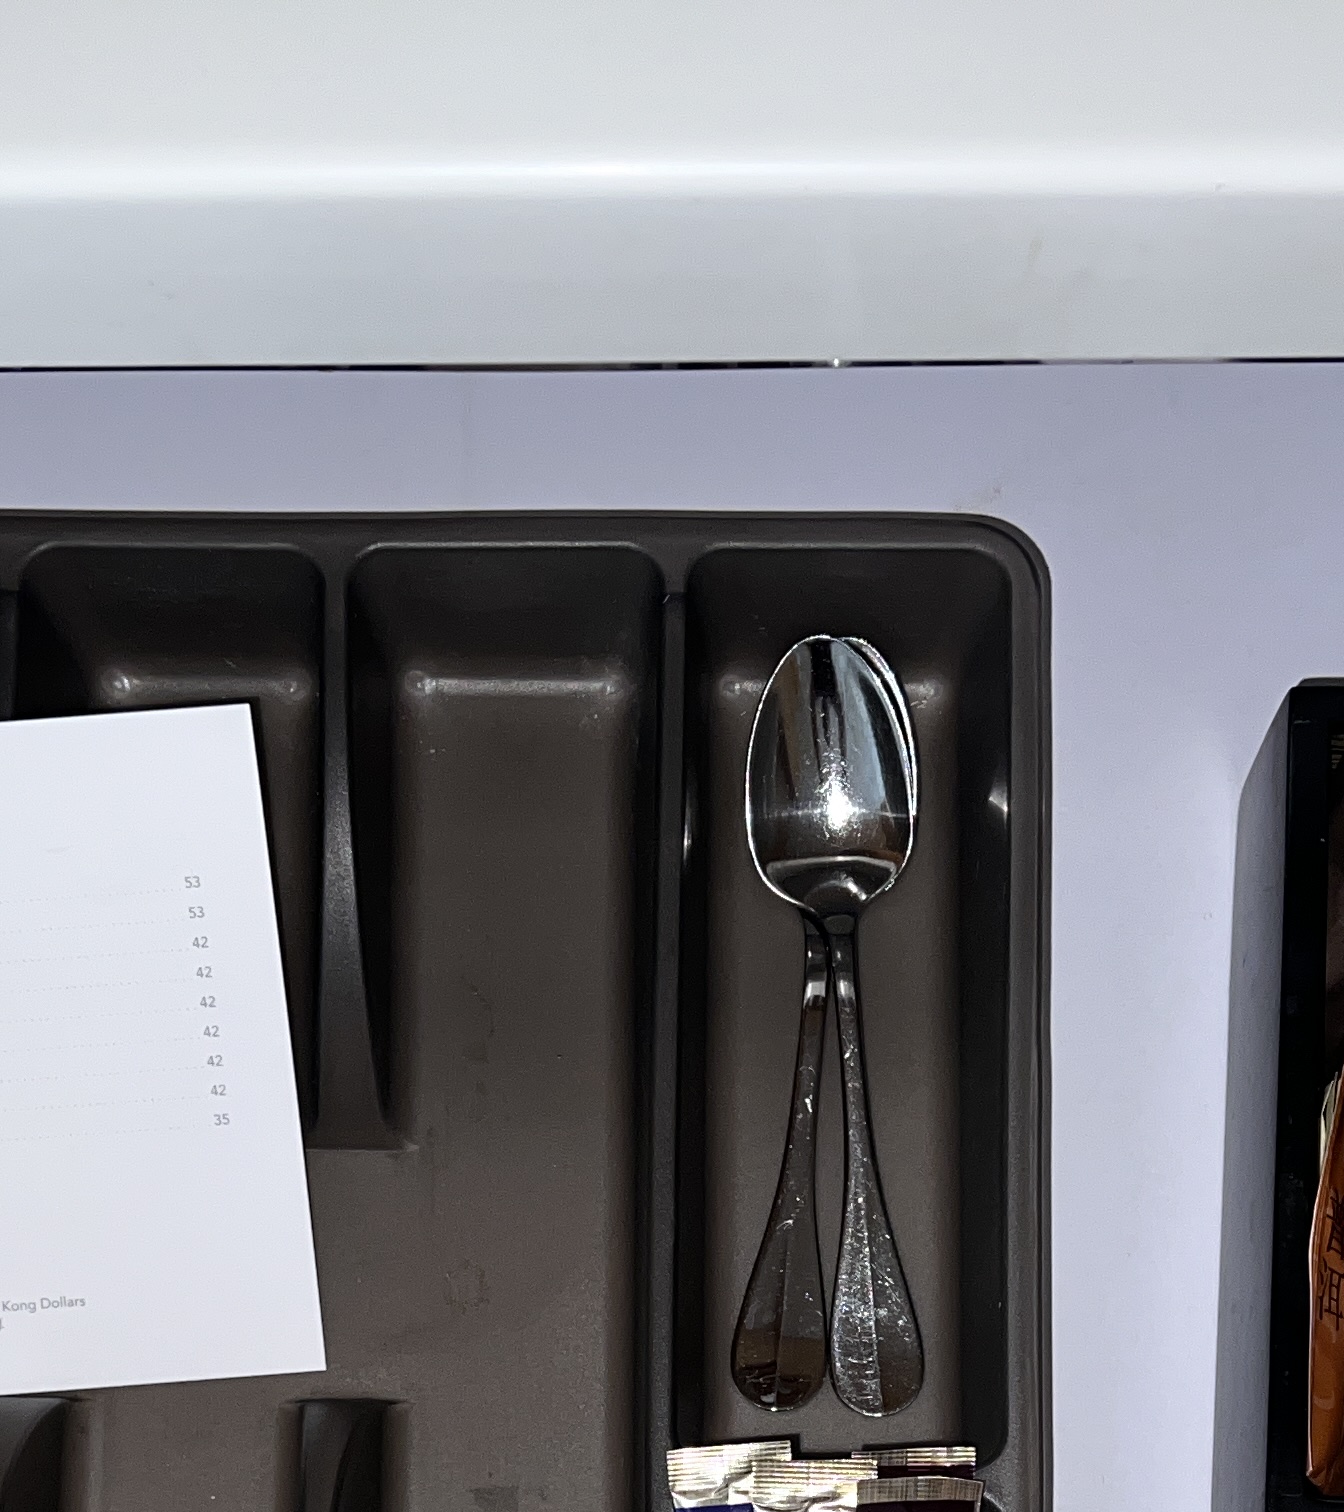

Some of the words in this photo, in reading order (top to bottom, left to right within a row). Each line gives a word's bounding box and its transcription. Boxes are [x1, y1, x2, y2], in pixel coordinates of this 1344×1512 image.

[184, 876, 201, 889] 53
[188, 906, 205, 919] 53
[192, 936, 209, 949] 42
[196, 966, 213, 979] 42
[199, 995, 217, 1008] 42
[203, 1025, 220, 1038] 42
[206, 1054, 224, 1067] 42
[210, 1084, 227, 1096] 42
[213, 1113, 230, 1126] 35
[2, 1300, 37, 1313] Kong
[40, 1296, 86, 1310] Dollars
